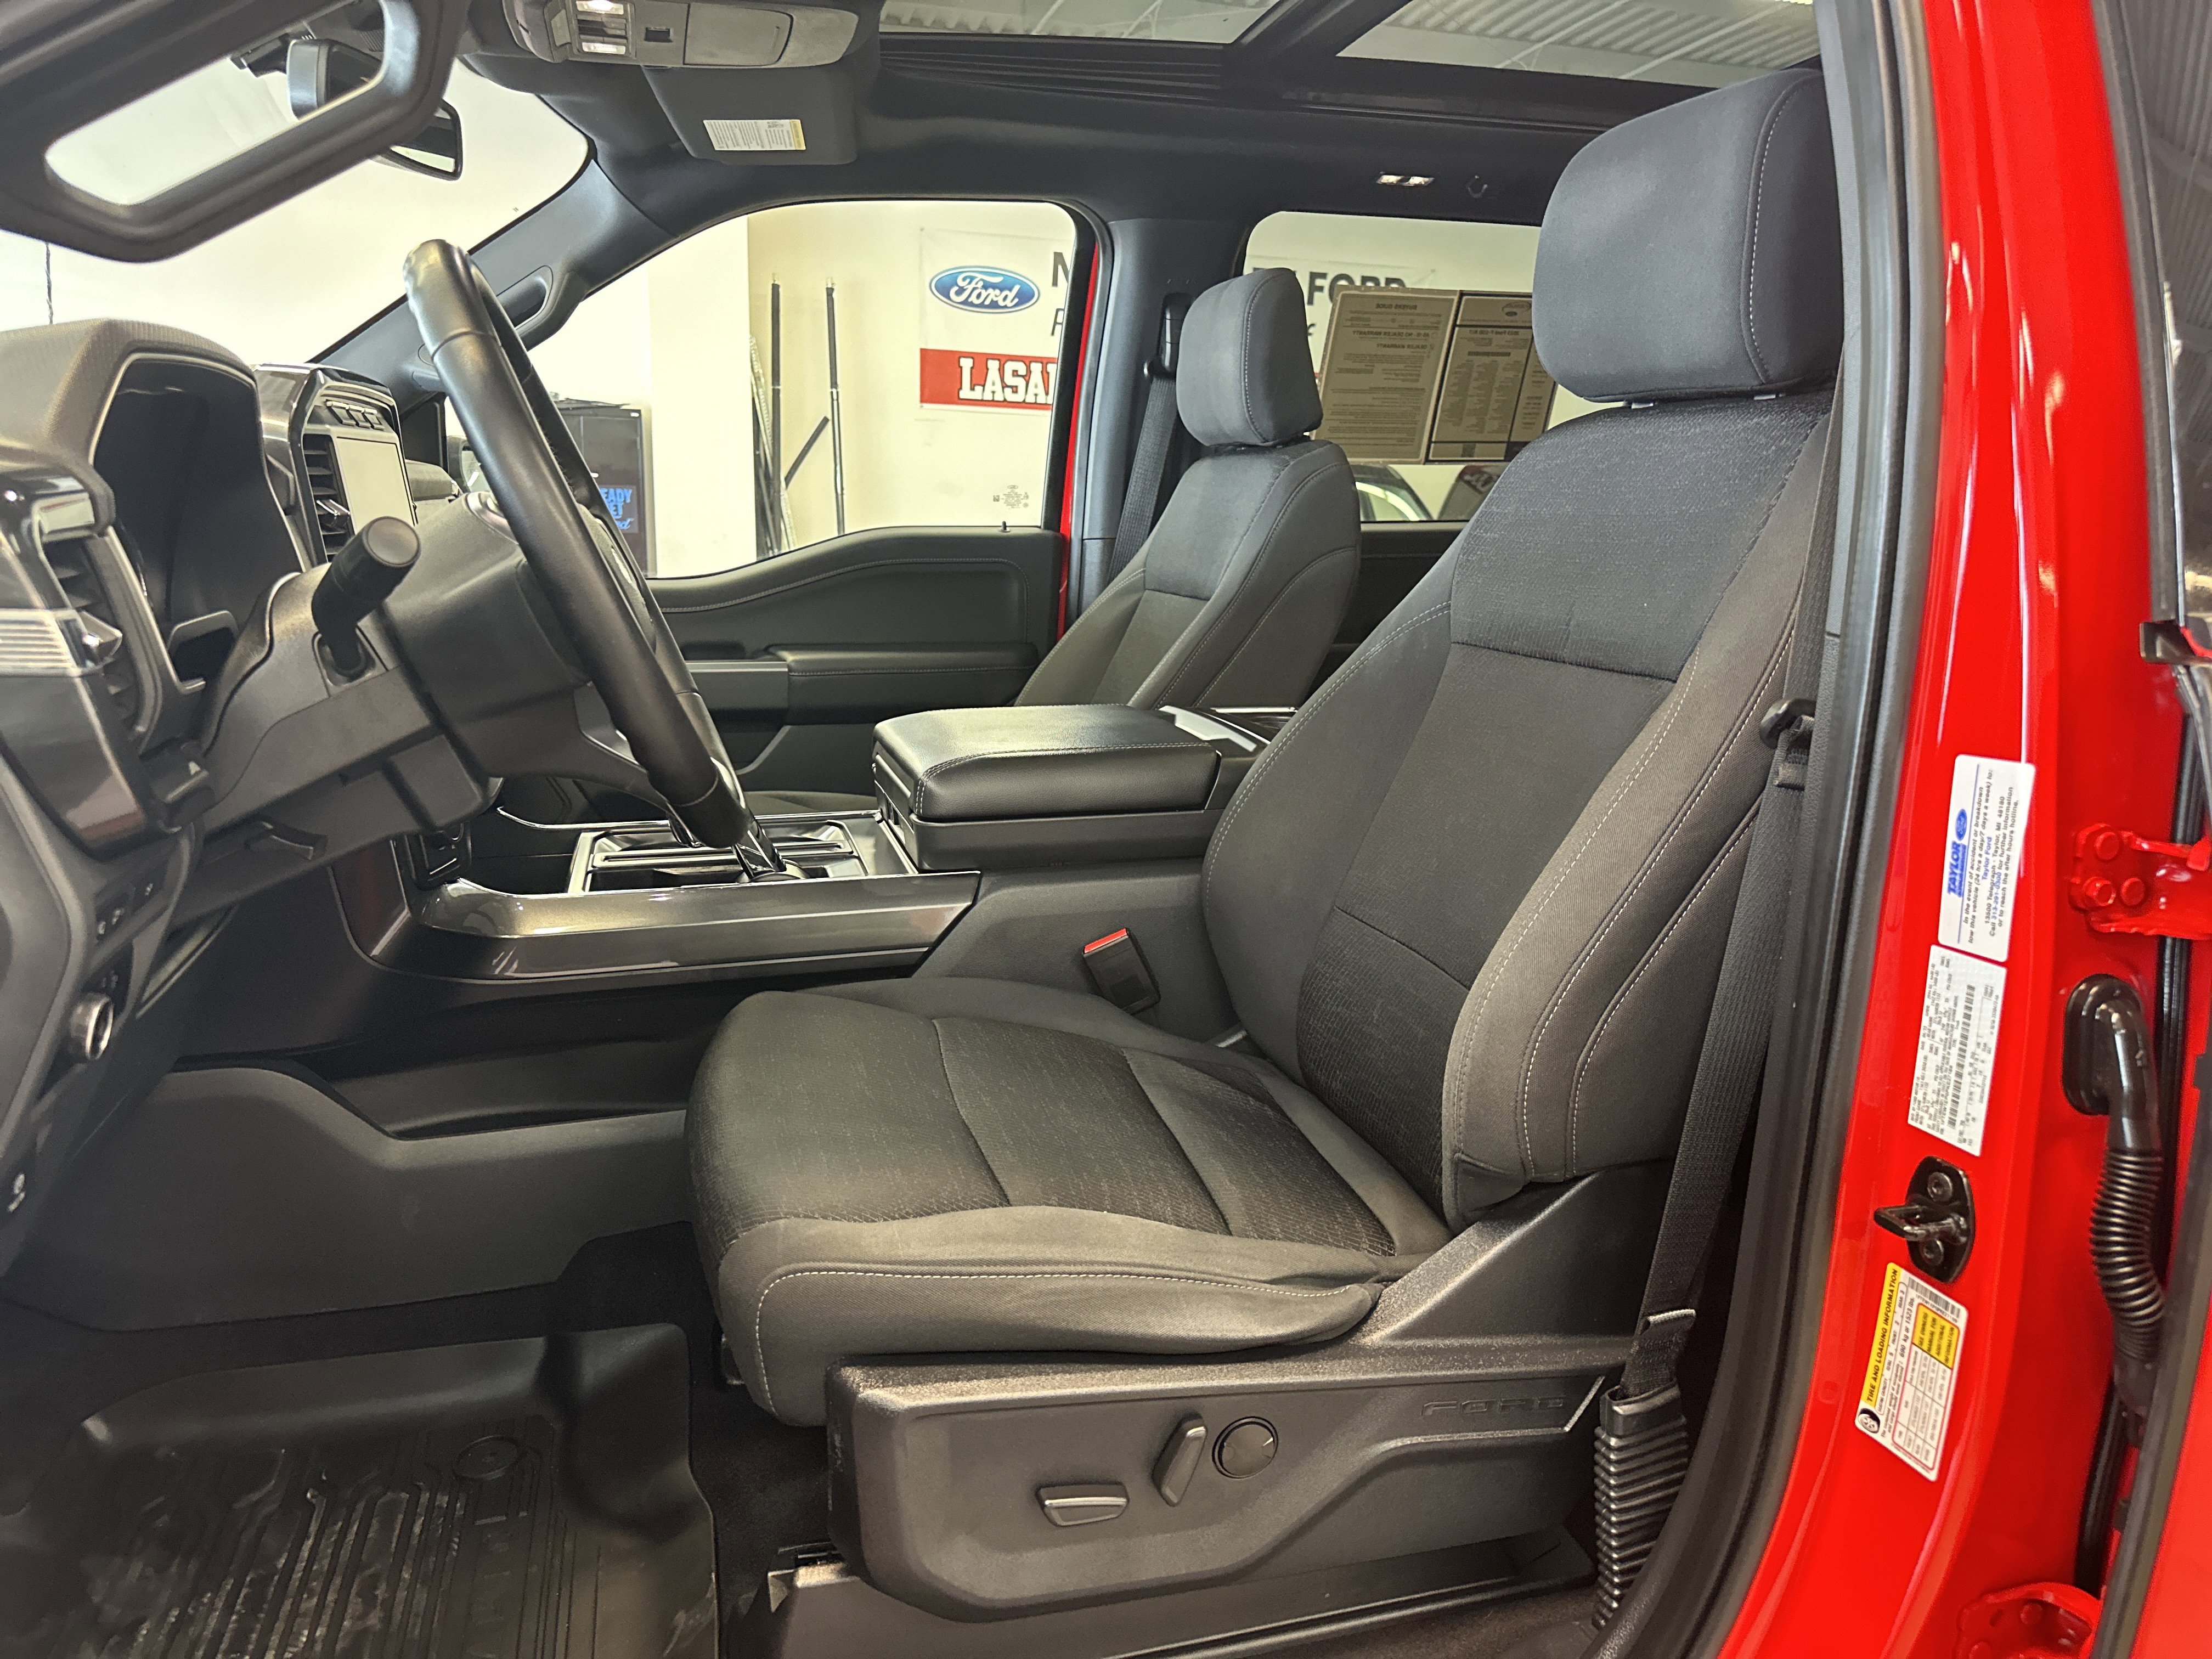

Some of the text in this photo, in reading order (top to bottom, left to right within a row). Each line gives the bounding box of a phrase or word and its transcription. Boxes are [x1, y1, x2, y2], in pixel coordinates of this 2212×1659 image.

[1973, 786, 1984, 828] breakdown
[2001, 786, 2013, 830] information
[1980, 811, 1989, 830] days
[1972, 828, 1979, 837] or
[2006, 829, 2015, 852] hours
[1998, 831, 2007, 857] further
[1968, 838, 1978, 870] accident
[1981, 836, 1994, 881] Taylor Ford
[1986, 864, 1999, 901] Telegraph
[1995, 821, 2002, 831] MI
[2003, 853, 2011, 871] after
[1946, 840, 1961, 895] TAYLOR
[1975, 859, 1983, 872] hrs
[1967, 871, 1974, 880] of
[1965, 881, 1973, 901] event
[1970, 886, 1980, 913] vehicle
[1998, 886, 2007, 908] reach
[1962, 915, 1970, 924] In
[1968, 913, 1977, 929] this
[1996, 917, 2003, 927] or
[1997, 909, 2004, 917] to
[1904, 1307, 1912, 1325] 1523
[1866, 1267, 1899, 1404] TIRE AND LOADING INFORMATION
[1901, 1332, 1909, 1344] kg
[1904, 1324, 1910, 1334] or
